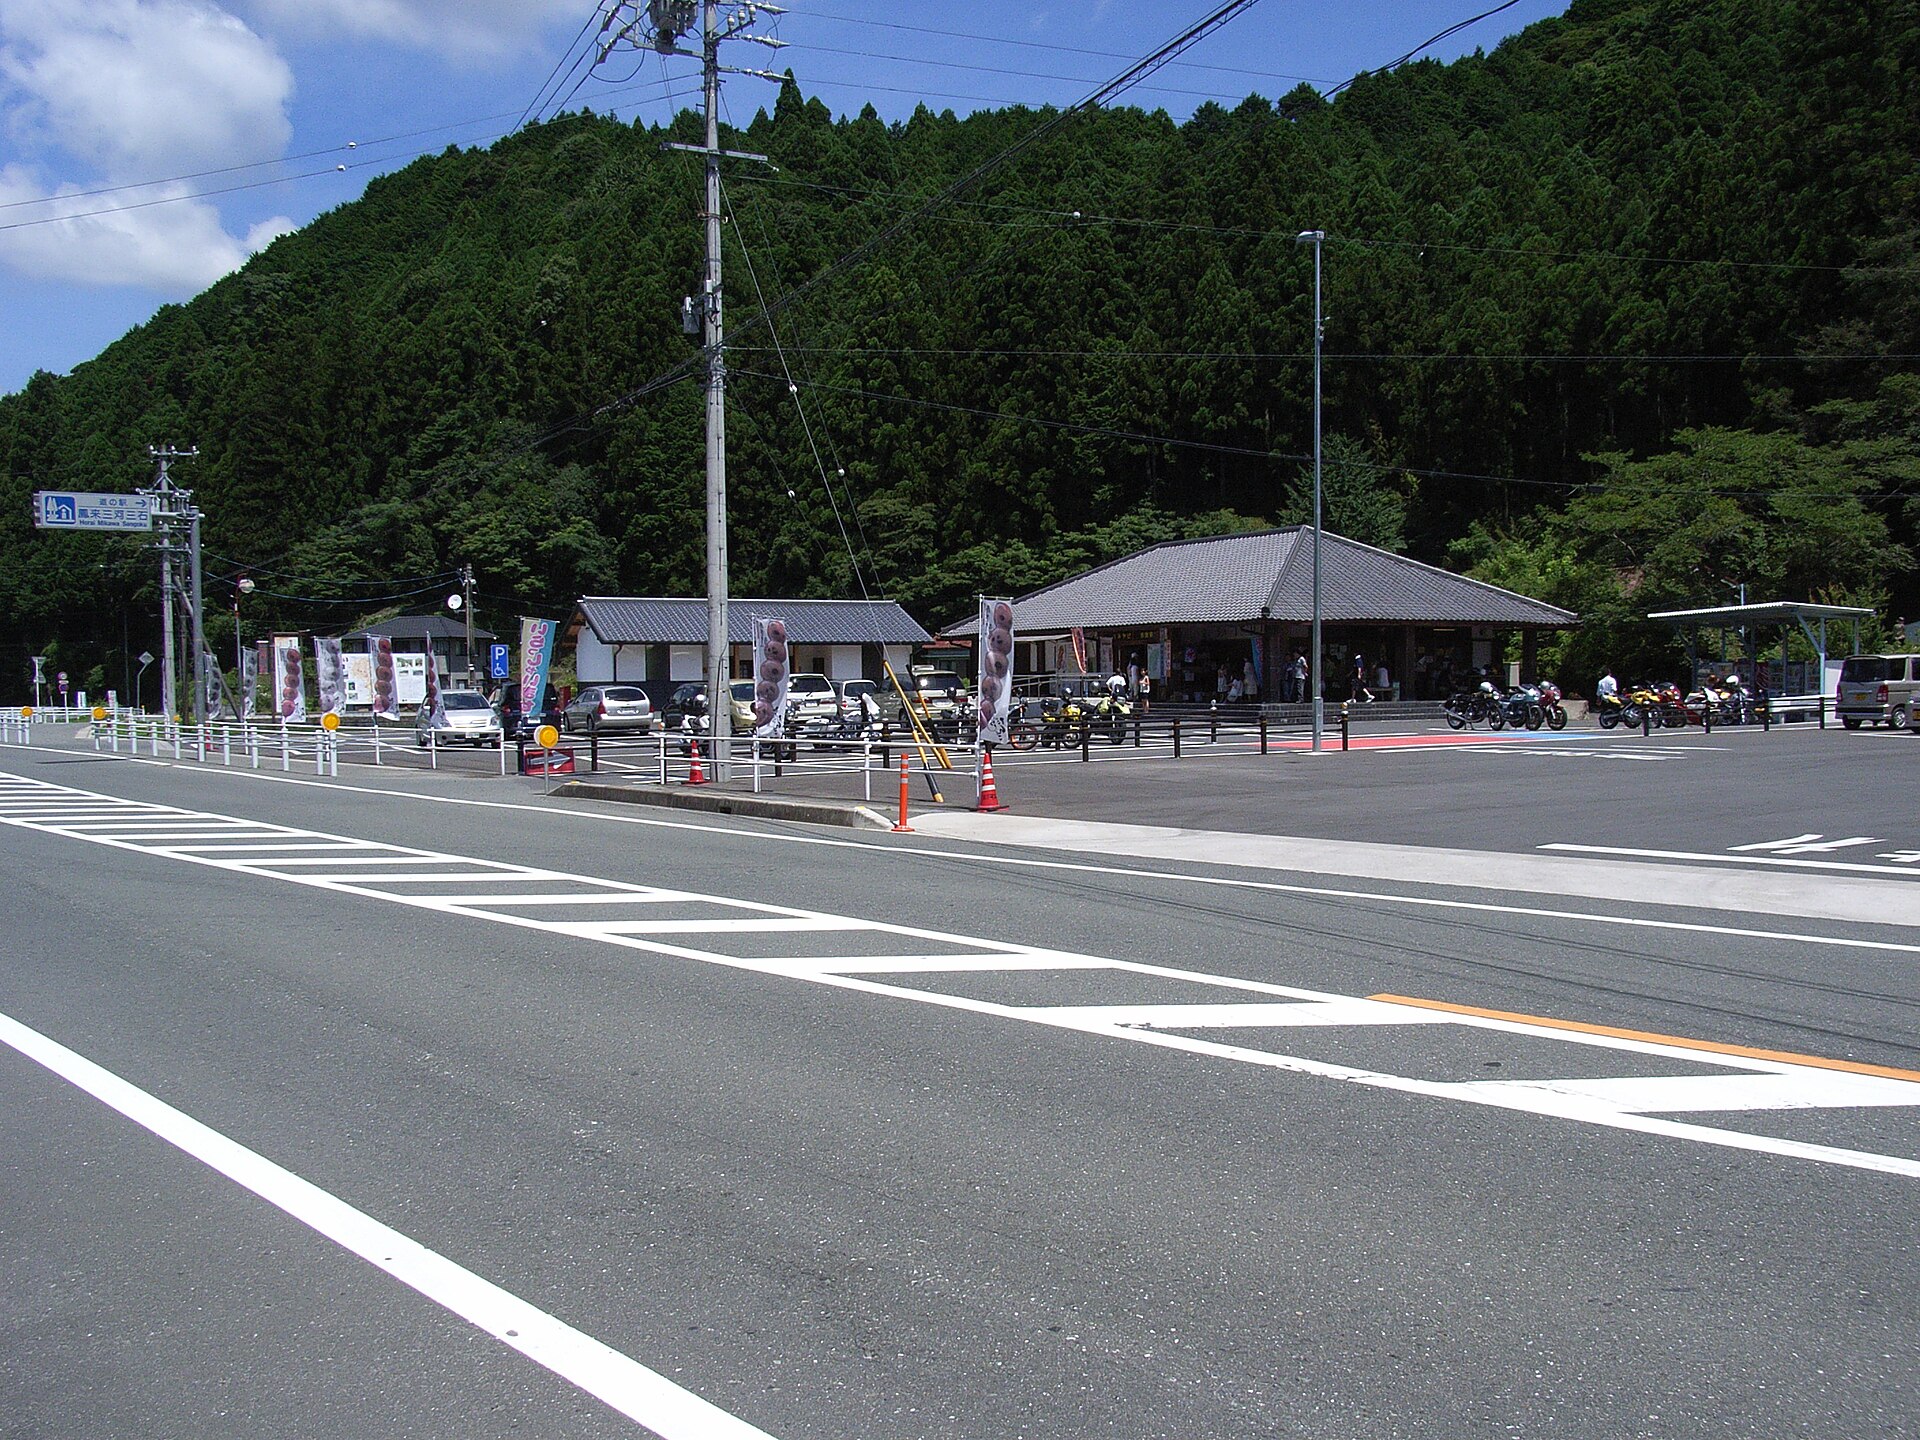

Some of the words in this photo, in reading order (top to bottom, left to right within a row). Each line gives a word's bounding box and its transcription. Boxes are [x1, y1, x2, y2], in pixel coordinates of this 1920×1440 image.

[99, 498, 128, 506] 道の駅
[496, 647, 505, 660] P
